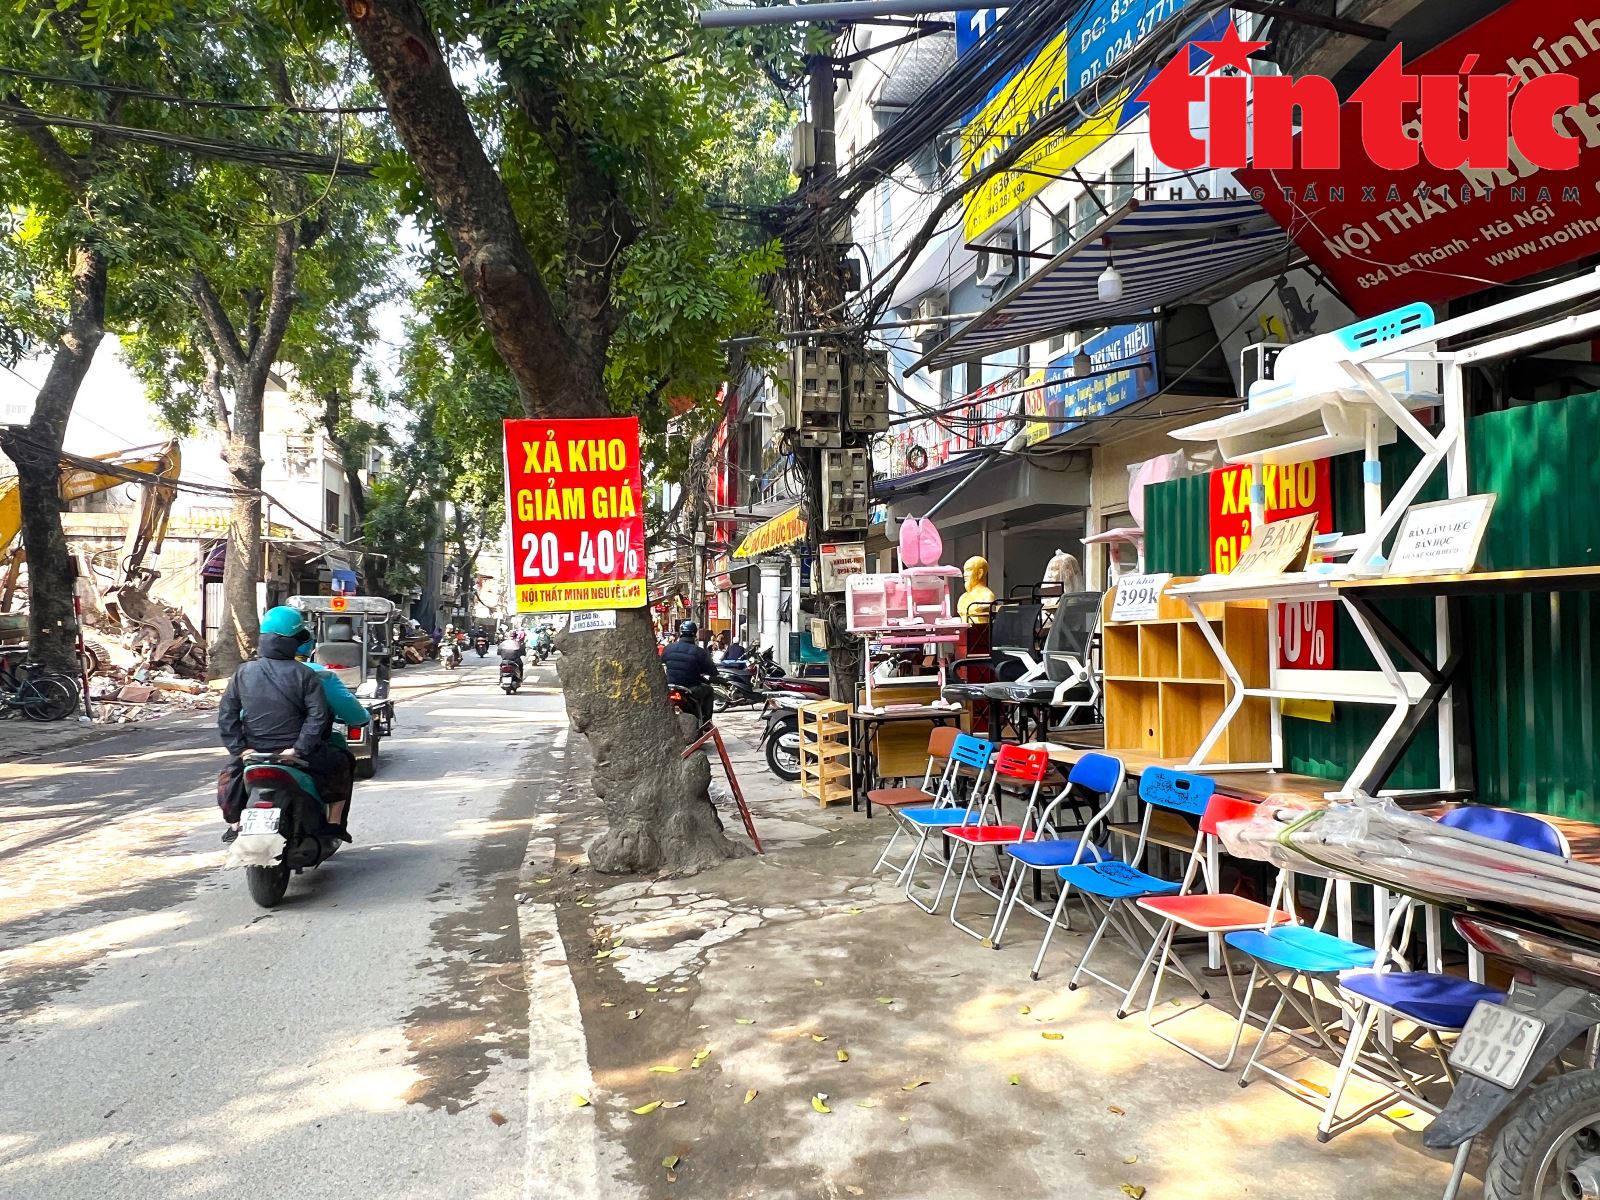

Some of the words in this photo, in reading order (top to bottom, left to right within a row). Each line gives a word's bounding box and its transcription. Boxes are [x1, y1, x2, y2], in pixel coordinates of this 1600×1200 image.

[1323, 221, 1381, 259] NỘI
[1376, 180, 1460, 236] THẤT
[1356, 268, 1389, 290] 834
[1389, 257, 1413, 277] La
[1409, 236, 1470, 270] Thành
[1479, 218, 1514, 245] Hà
[1512, 202, 1556, 230] Nội
[1485, 226, 1600, 268] www.noith
[1123, 322, 1150, 358] HIẾU
[522, 430, 563, 474] XẢ
[568, 438, 626, 473] KHO
[517, 478, 586, 522] GIẢM
[592, 478, 636, 519] GIÁ
[1262, 460, 1316, 511] KHO
[521, 588, 538, 606] NỘI
[539, 584, 561, 602] THẤT
[564, 588, 589, 600] MINH
[1117, 587, 1158, 607] 399k
[1277, 601, 1325, 666] 0%
[1459, 1036, 1517, 1078] 9797
